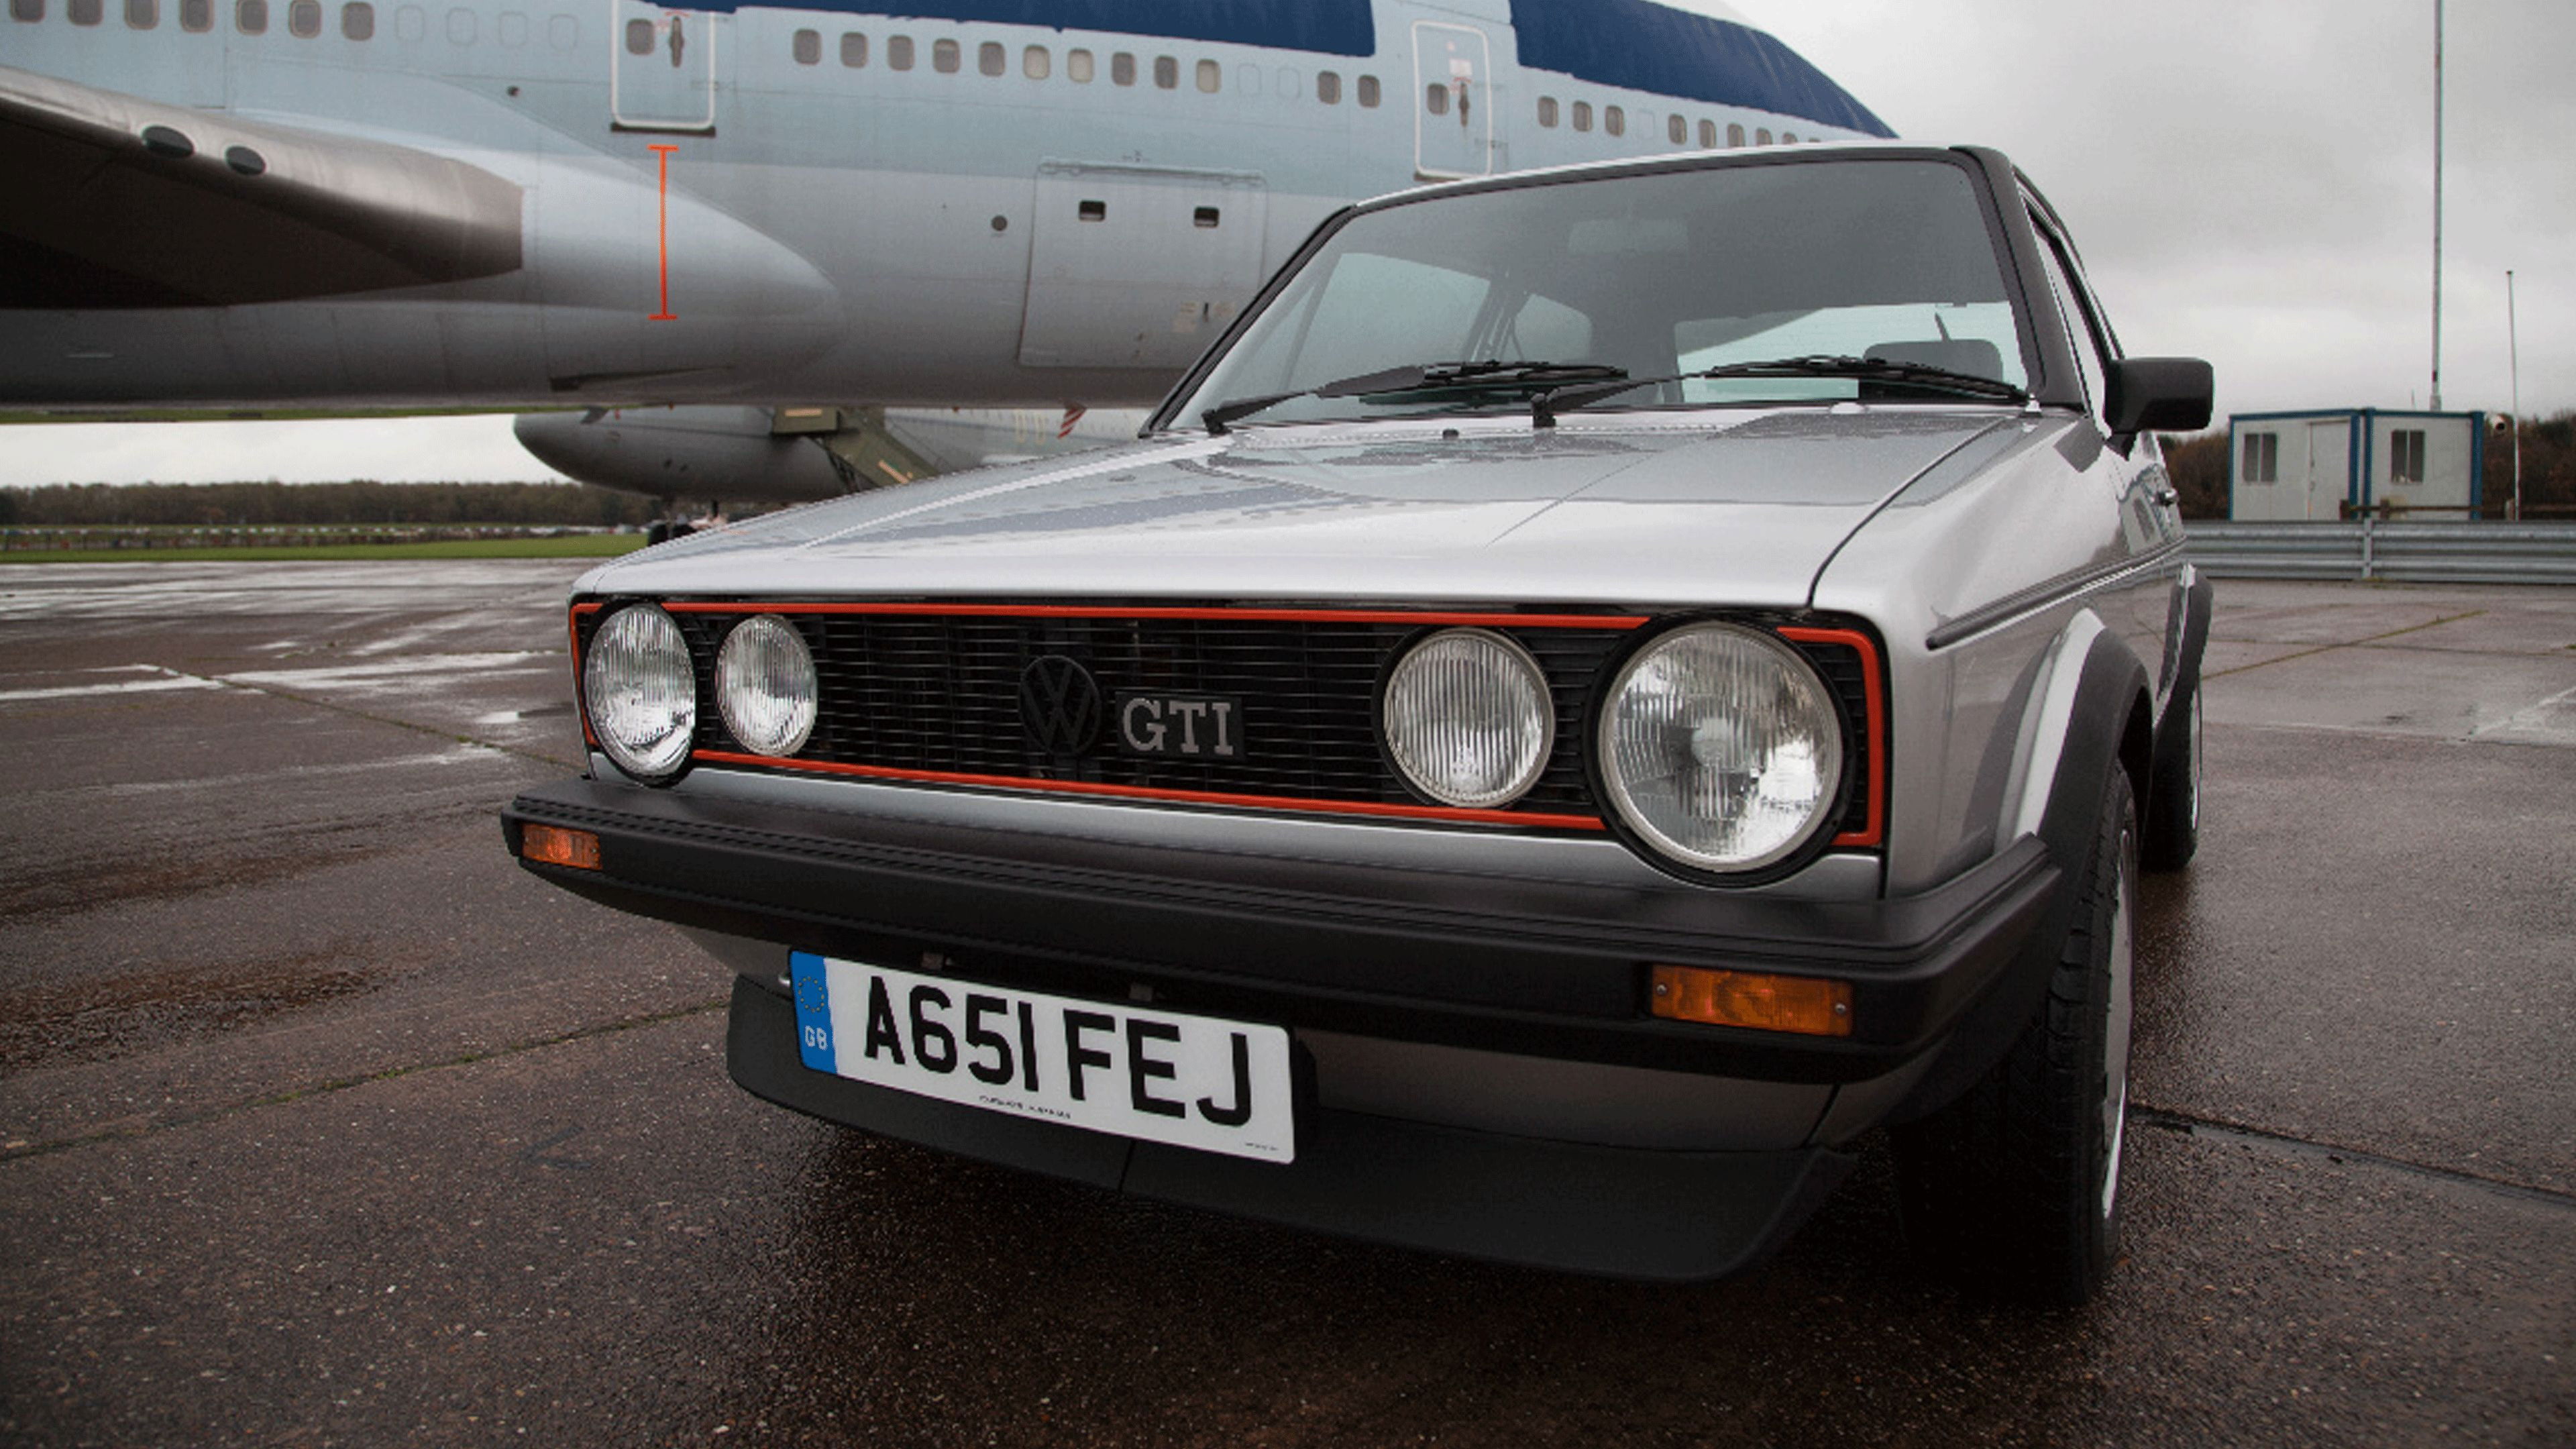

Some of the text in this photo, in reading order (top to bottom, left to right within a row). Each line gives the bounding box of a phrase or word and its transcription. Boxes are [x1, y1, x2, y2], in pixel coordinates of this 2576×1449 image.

[1020, 656, 1101, 755] VW
[1123, 698, 1233, 755] GTI
[804, 1025, 828, 1051] GB
[864, 975, 1252, 1128] A651 FEJ
